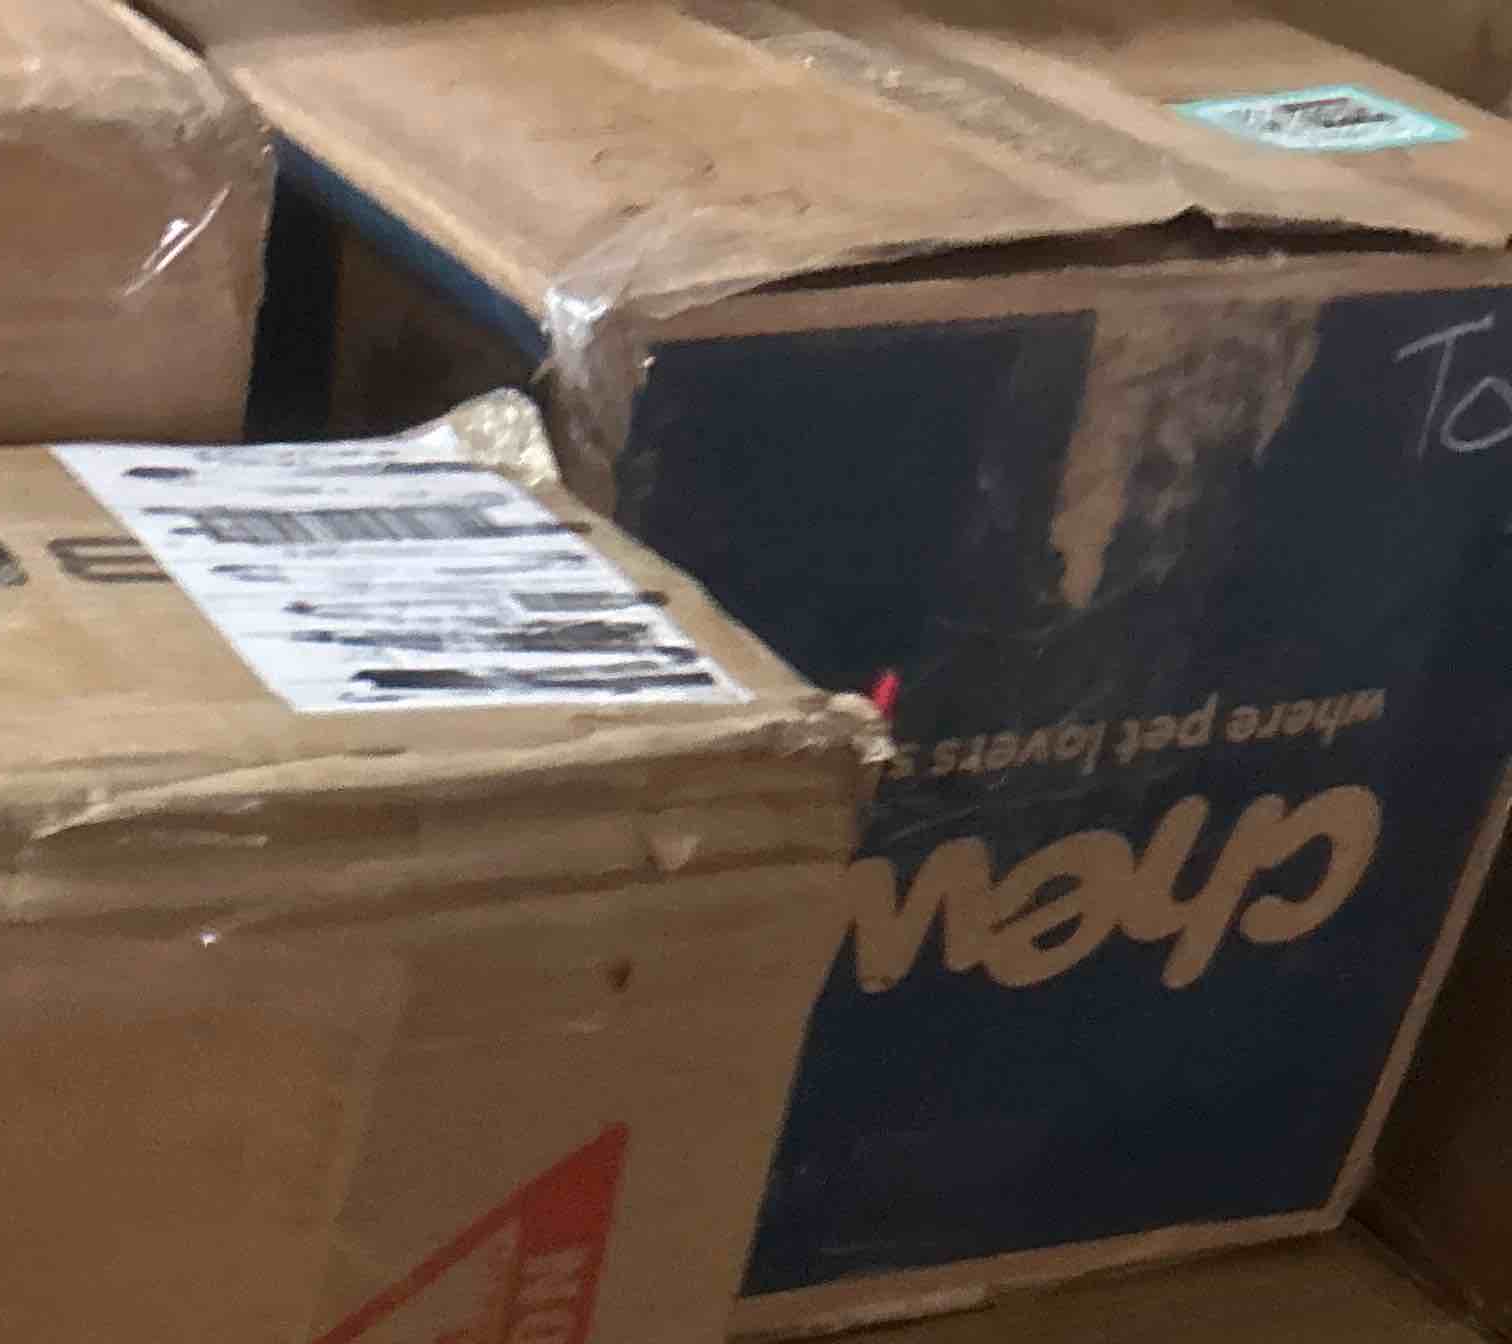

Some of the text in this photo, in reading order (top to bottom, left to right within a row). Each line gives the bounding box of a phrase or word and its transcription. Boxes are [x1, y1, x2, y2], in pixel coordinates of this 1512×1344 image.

[933, 687, 1387, 777] where pet lovers
[846, 784, 1384, 995] chew
